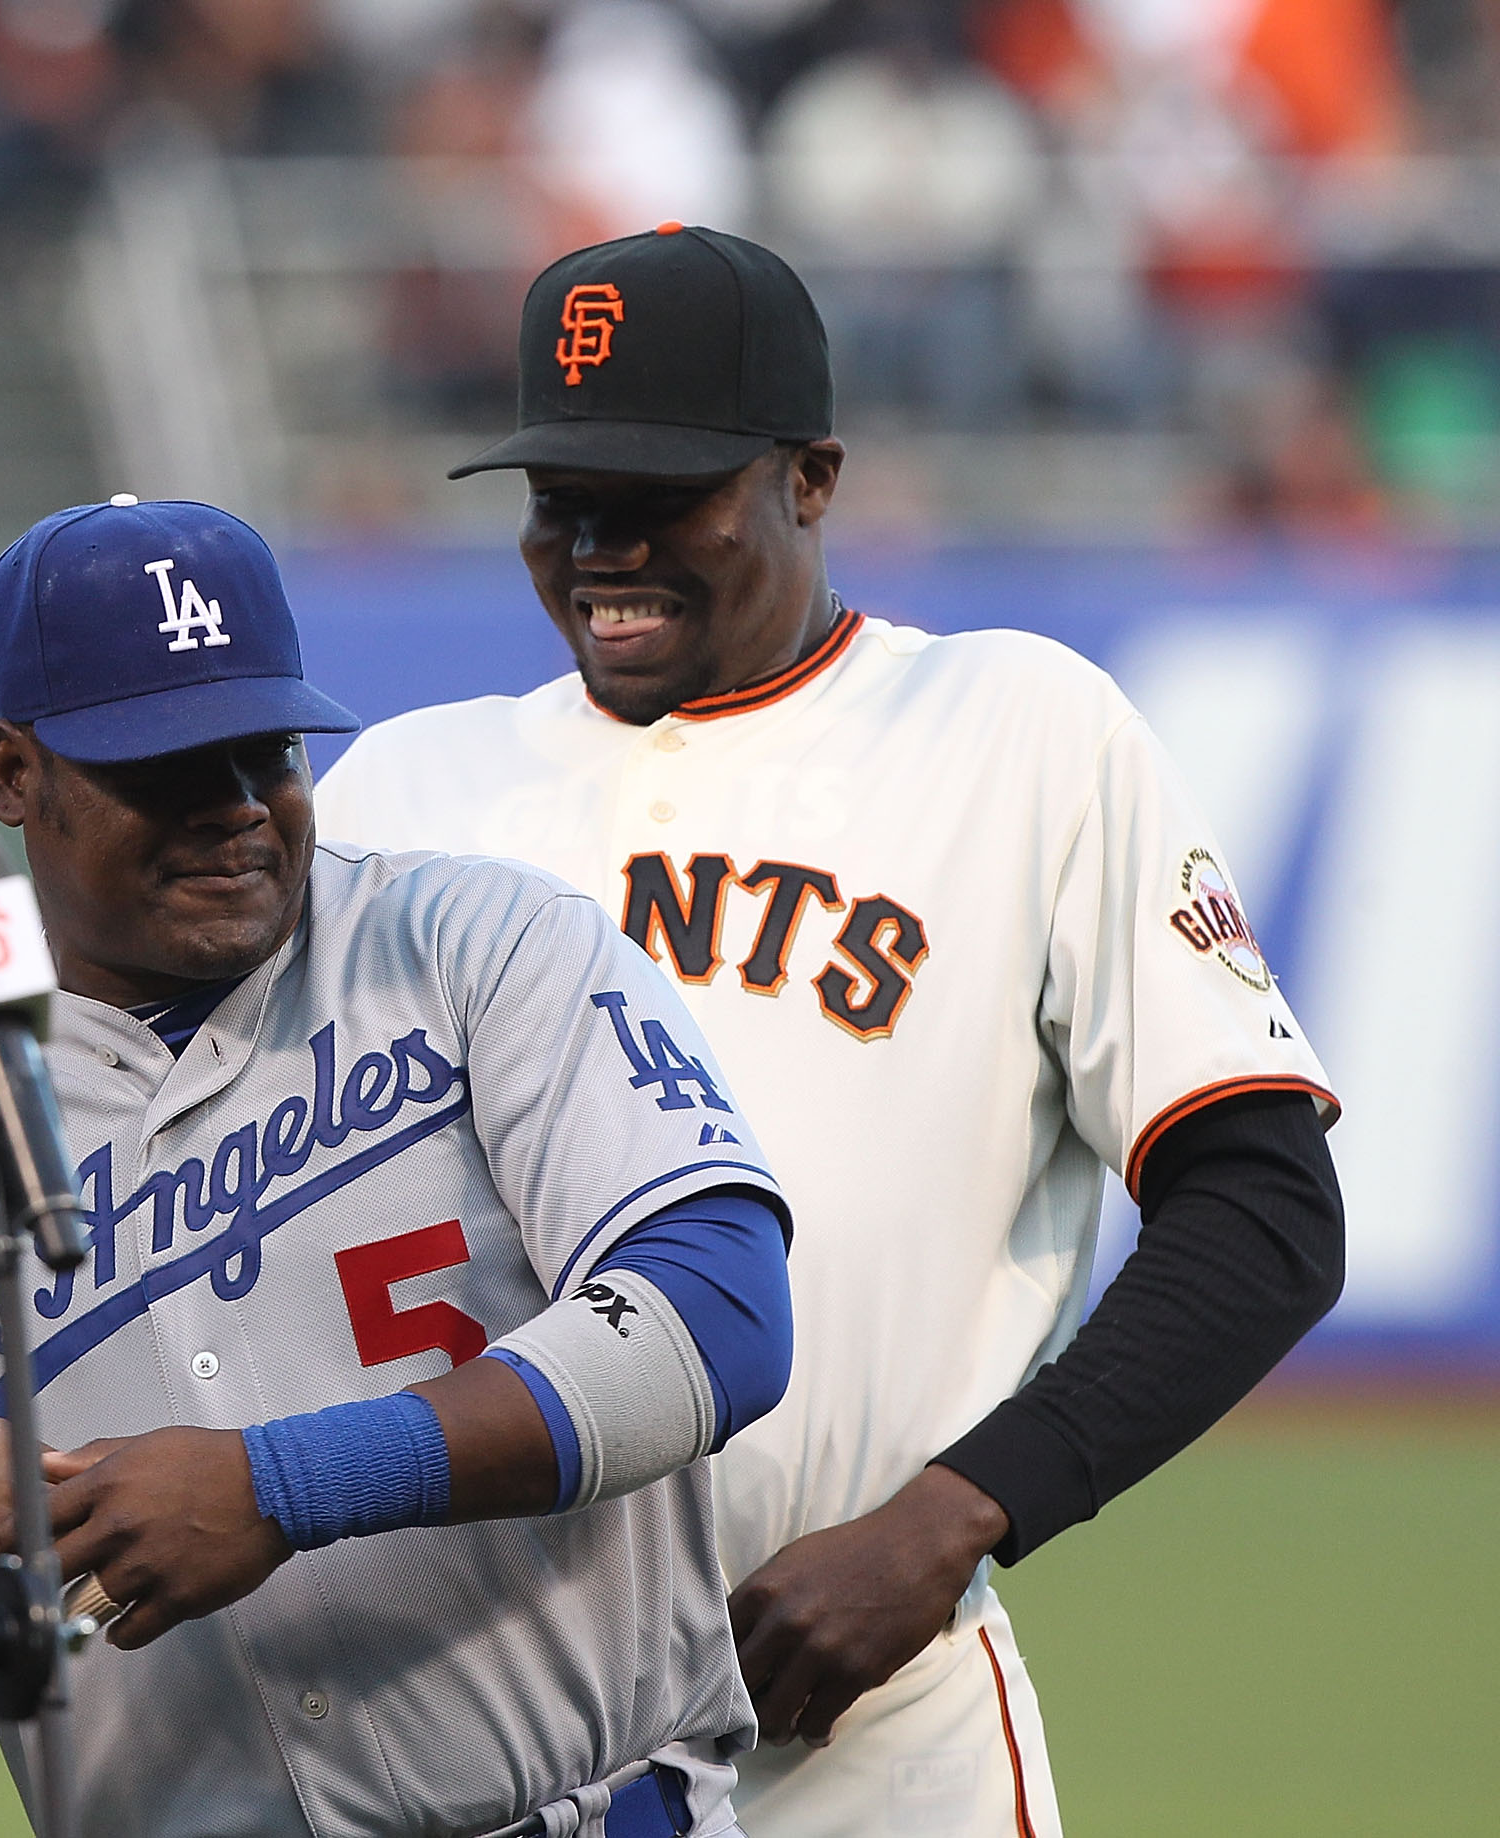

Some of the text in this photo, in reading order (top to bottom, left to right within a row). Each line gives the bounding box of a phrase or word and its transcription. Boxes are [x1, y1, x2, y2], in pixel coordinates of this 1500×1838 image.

[555, 282, 624, 387] SF
[144, 558, 231, 652] LA
[590, 990, 735, 1114] LA
[33, 1020, 468, 1320] Angeles
[334, 1219, 489, 1368] 5
